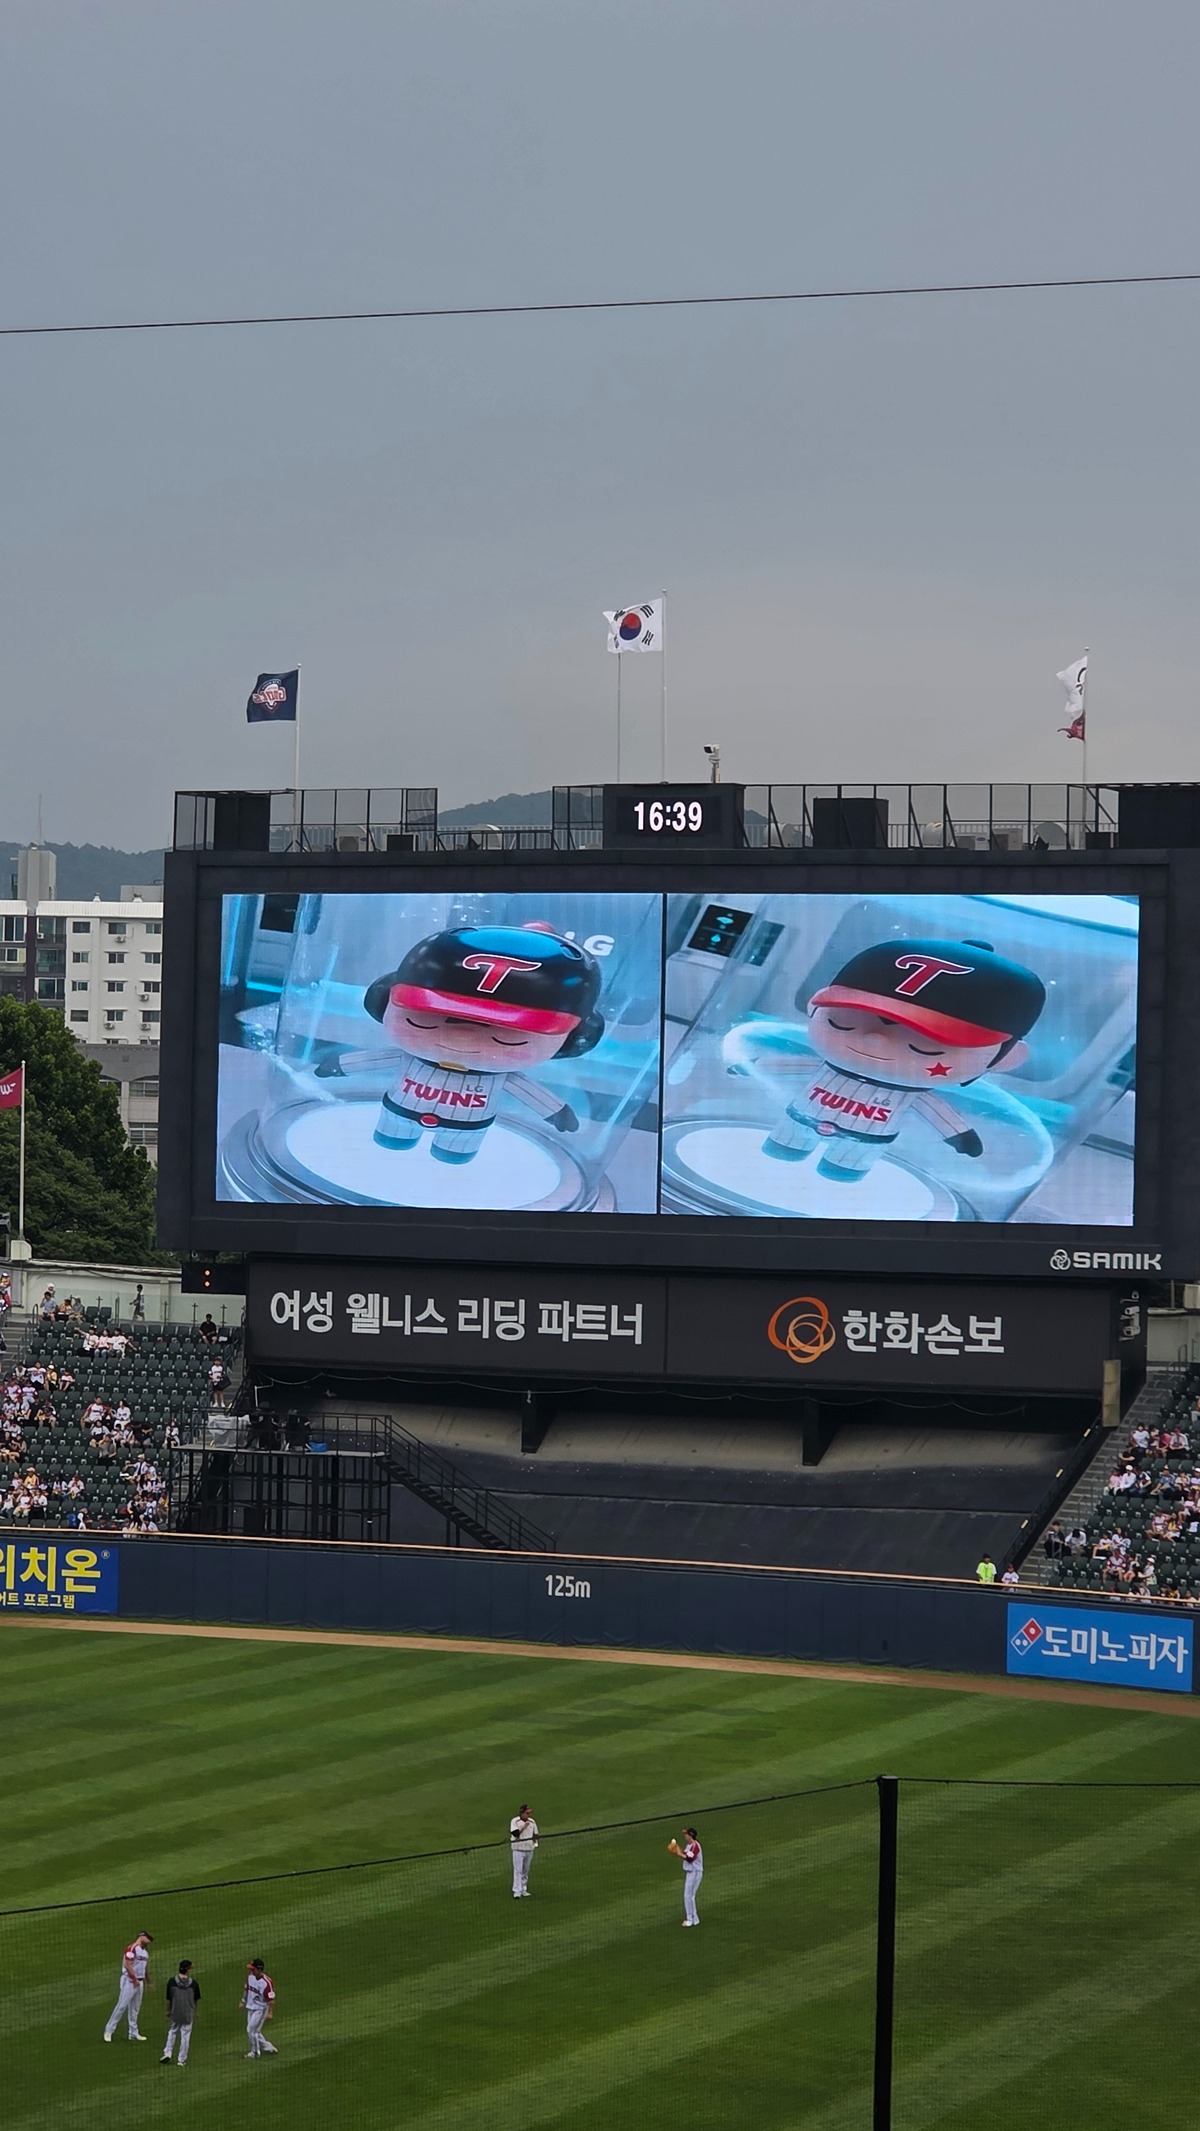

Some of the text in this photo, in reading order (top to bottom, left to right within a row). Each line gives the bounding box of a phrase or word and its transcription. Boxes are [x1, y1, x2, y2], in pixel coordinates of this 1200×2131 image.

[633, 801, 703, 832] 16:39
[462, 953, 543, 993] T
[895, 953, 975, 997] T
[403, 1078, 488, 1108] TWINS
[466, 1084, 484, 1093] LG
[808, 1086, 893, 1123] TWINS
[1072, 1251, 1163, 1271] SAMIK
[269, 1289, 644, 1346] 여성 웰니스 리딩 파트너
[842, 1309, 1005, 1356] 한화손보
[23, 1593, 75, 1609] 프로그램
[545, 1574, 591, 1598] 125m
[1041, 1626, 1189, 1674] 도미노피자
